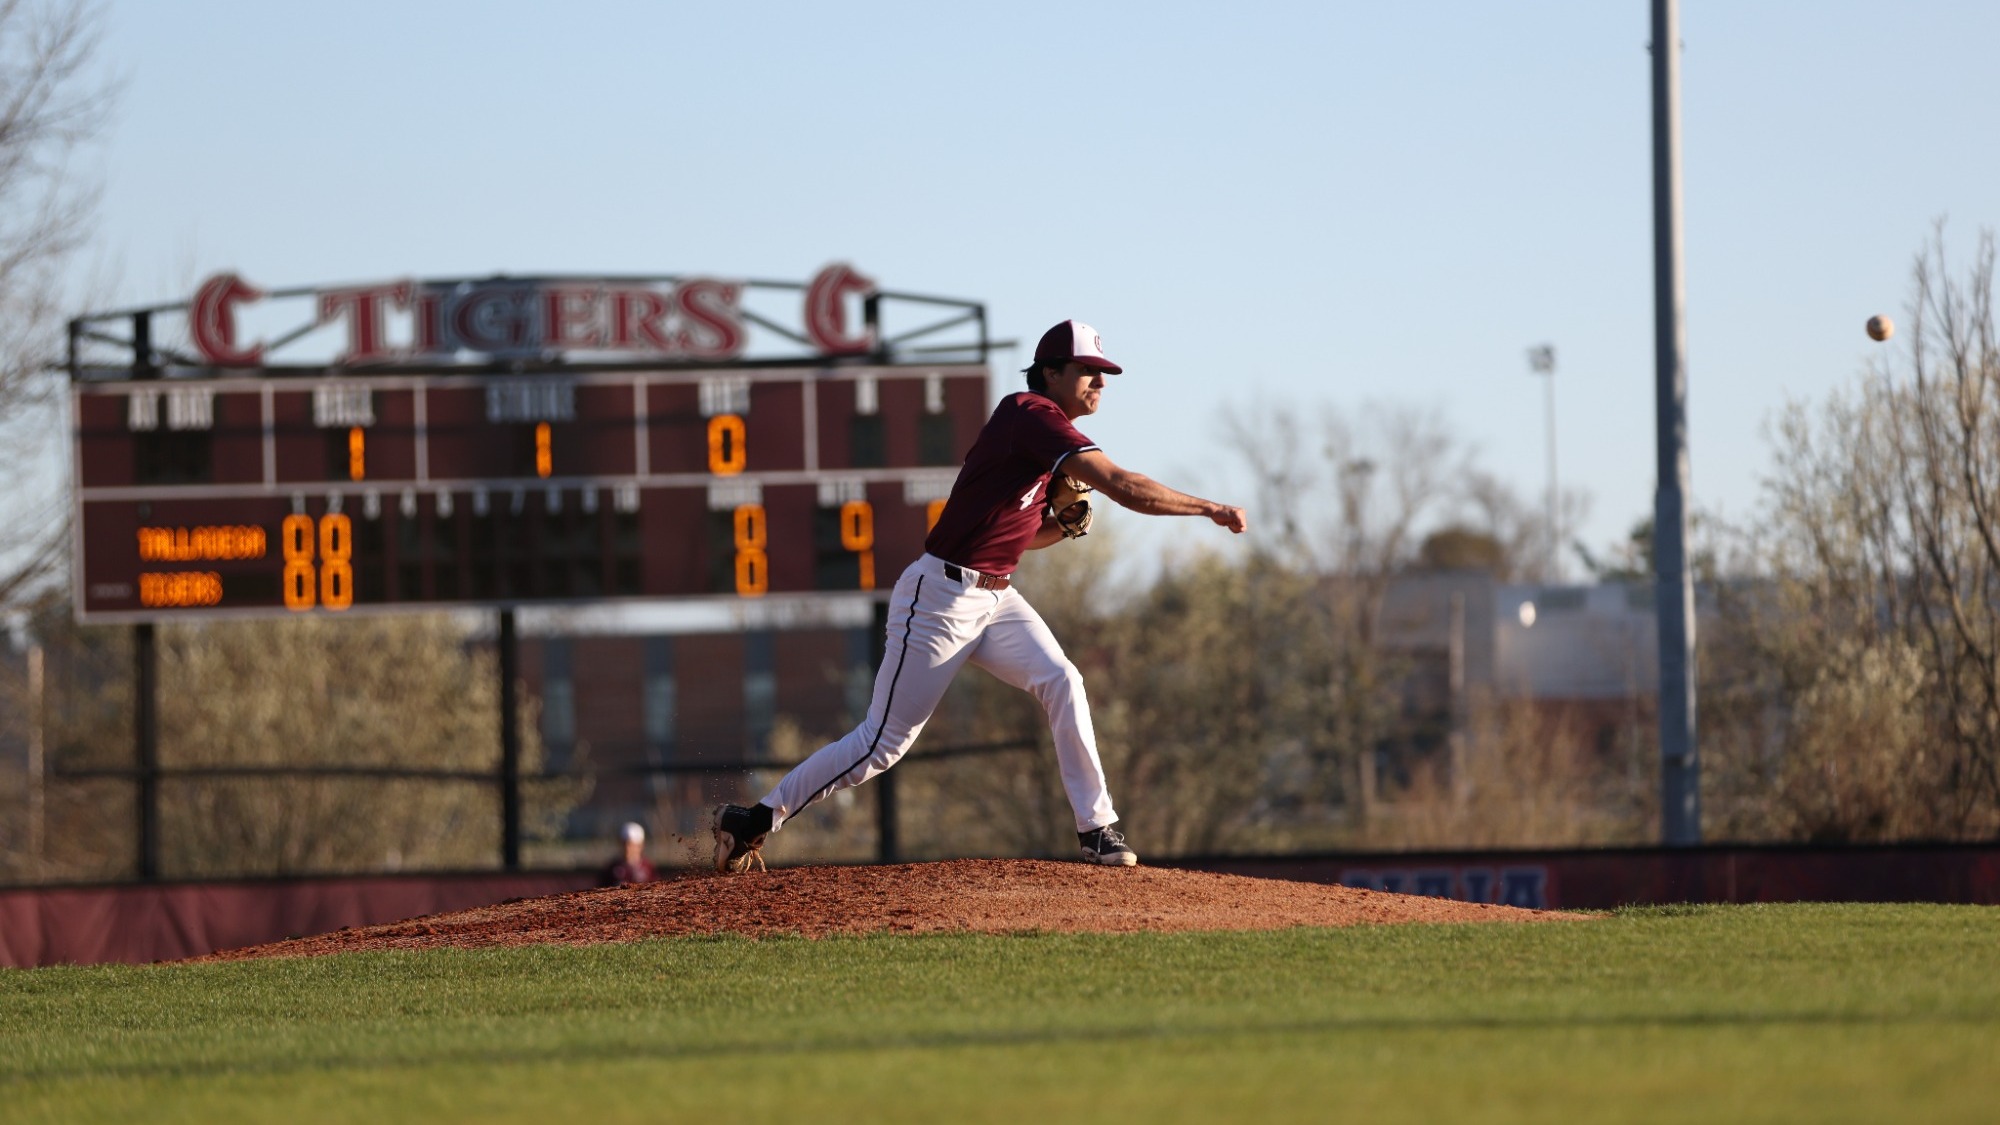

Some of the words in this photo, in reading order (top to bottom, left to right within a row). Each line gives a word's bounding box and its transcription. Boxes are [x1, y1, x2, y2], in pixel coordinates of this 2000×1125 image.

[191, 271, 264, 364] C
[317, 277, 747, 364] TIGERS
[805, 261, 876, 355] C
[349, 426, 365, 481] 1
[535, 421, 552, 478] 1
[707, 413, 747, 477] 0
[1020, 481, 1043, 510] 4
